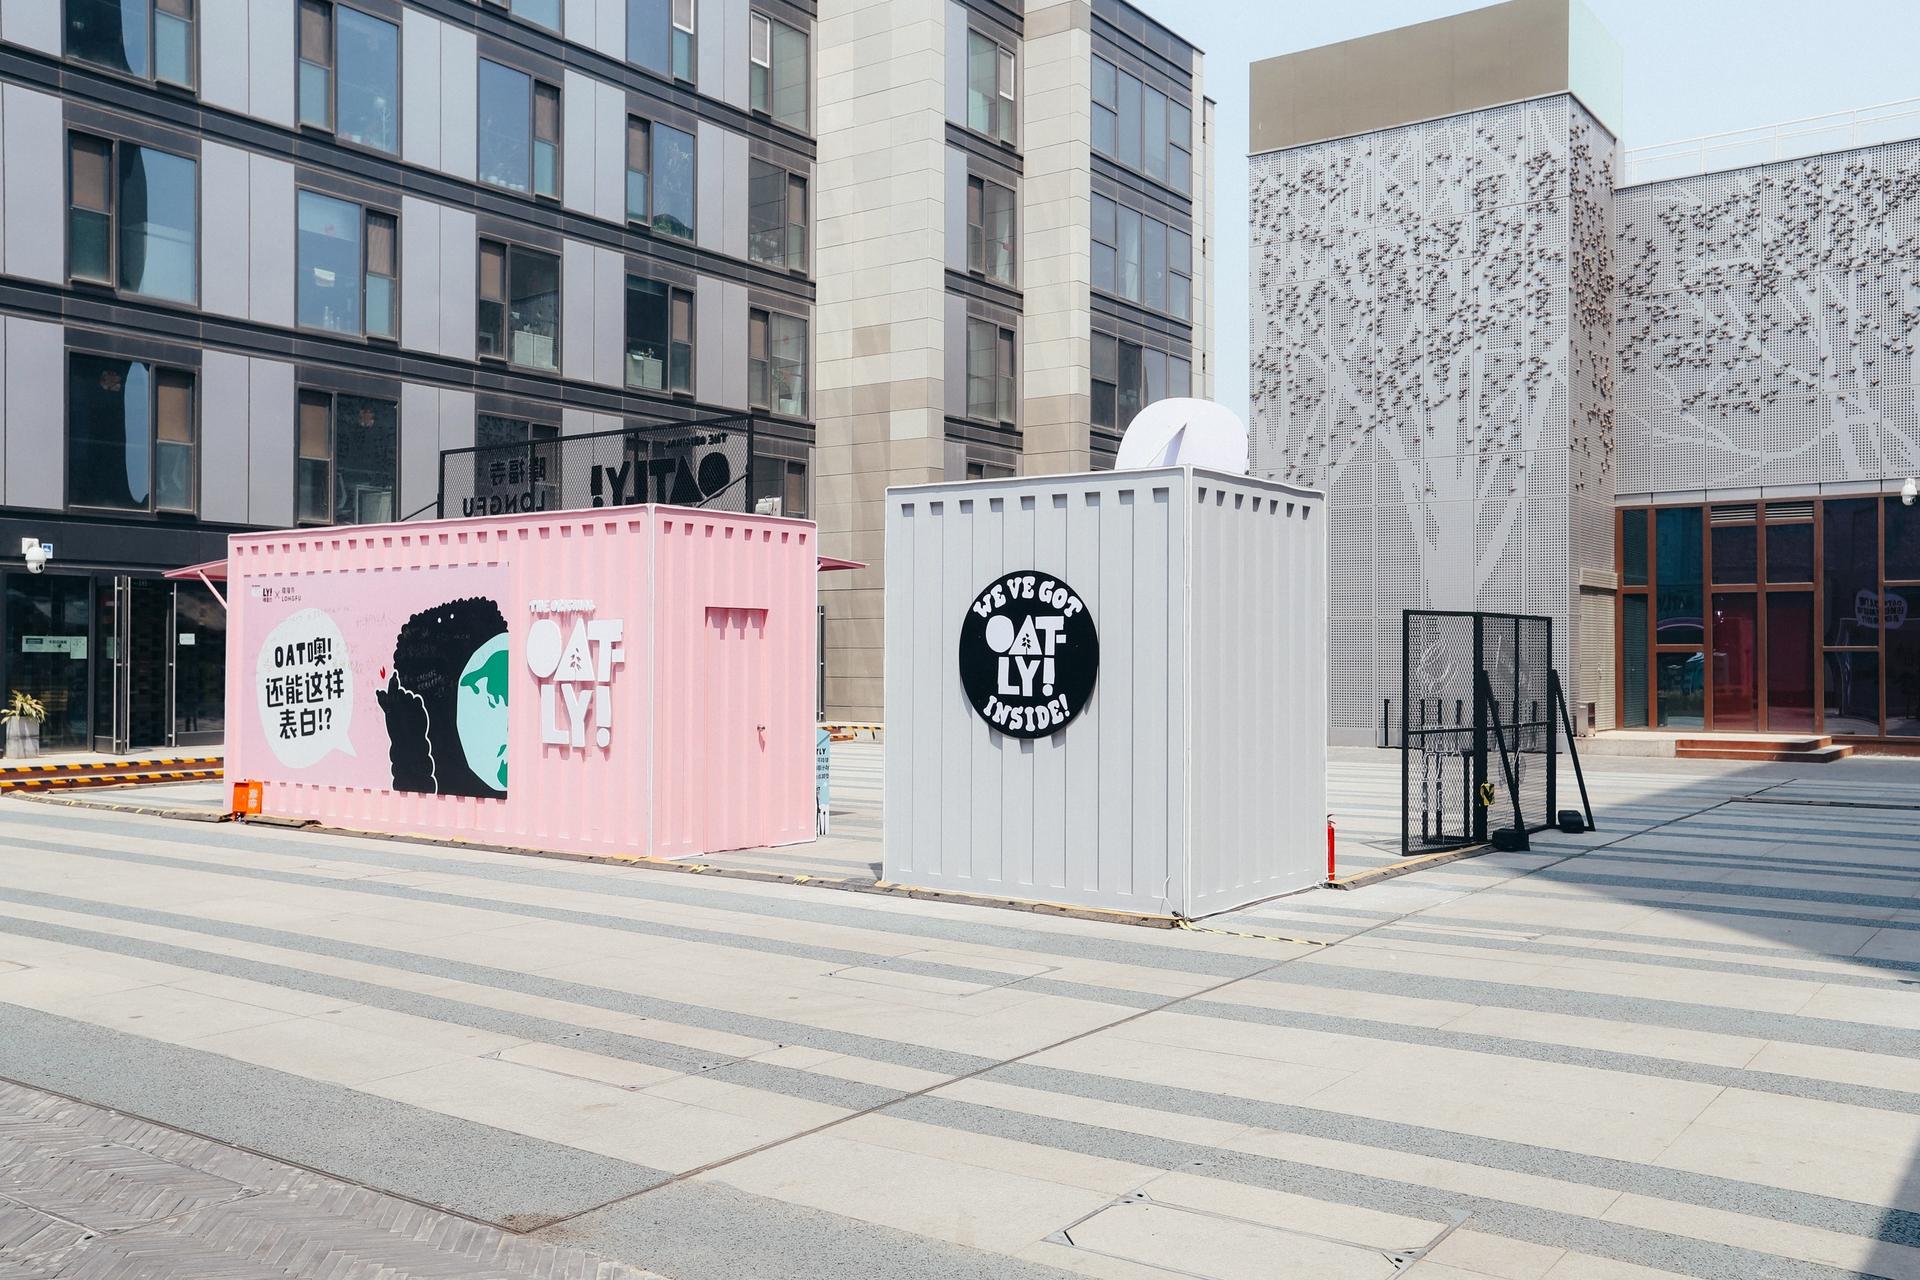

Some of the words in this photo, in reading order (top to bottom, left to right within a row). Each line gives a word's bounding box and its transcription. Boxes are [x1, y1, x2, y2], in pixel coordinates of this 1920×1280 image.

[1038, 580, 1083, 617] GOT
[266, 668, 344, 708] 还能这样
[997, 656, 1055, 697] LY!
[540, 683, 612, 748] LY!
[983, 693, 1070, 732] INSIDE!
